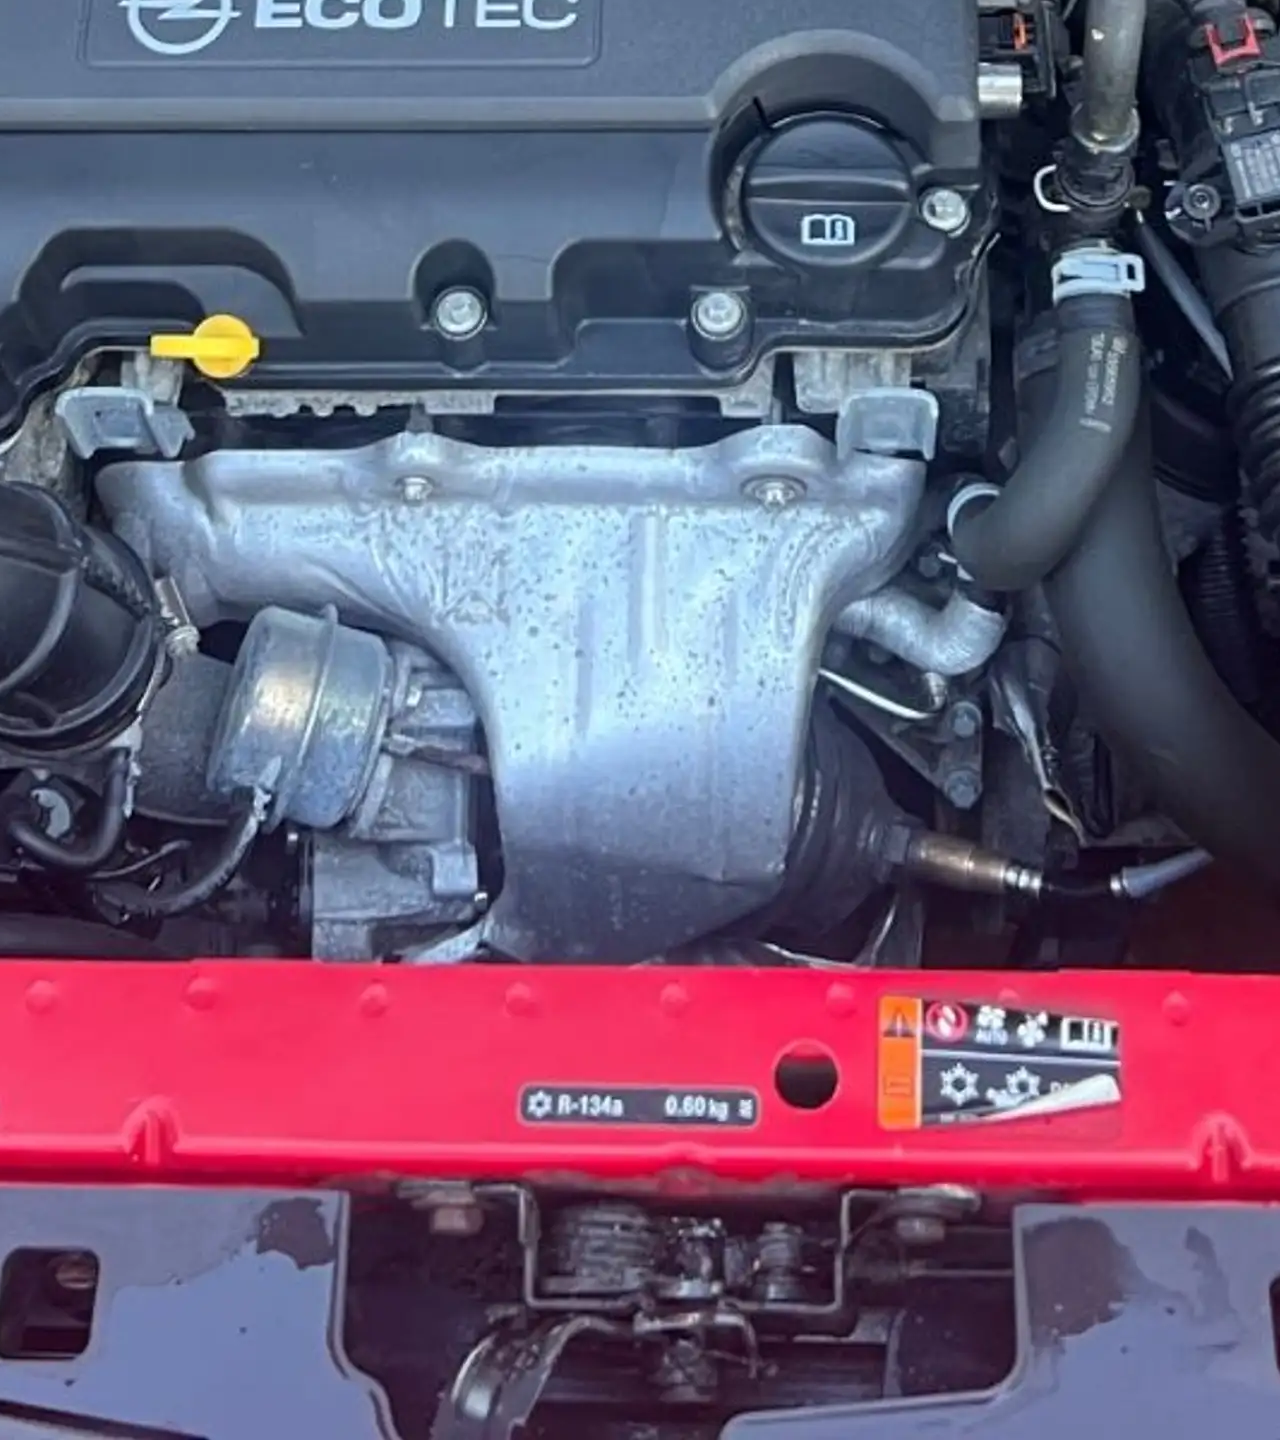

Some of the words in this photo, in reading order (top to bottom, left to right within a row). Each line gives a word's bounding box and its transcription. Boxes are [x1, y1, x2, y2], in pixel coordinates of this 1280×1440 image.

[557, 1093, 624, 1118] R-134a
[664, 1094, 706, 1118] 0.60
[708, 1097, 729, 1122] kg
